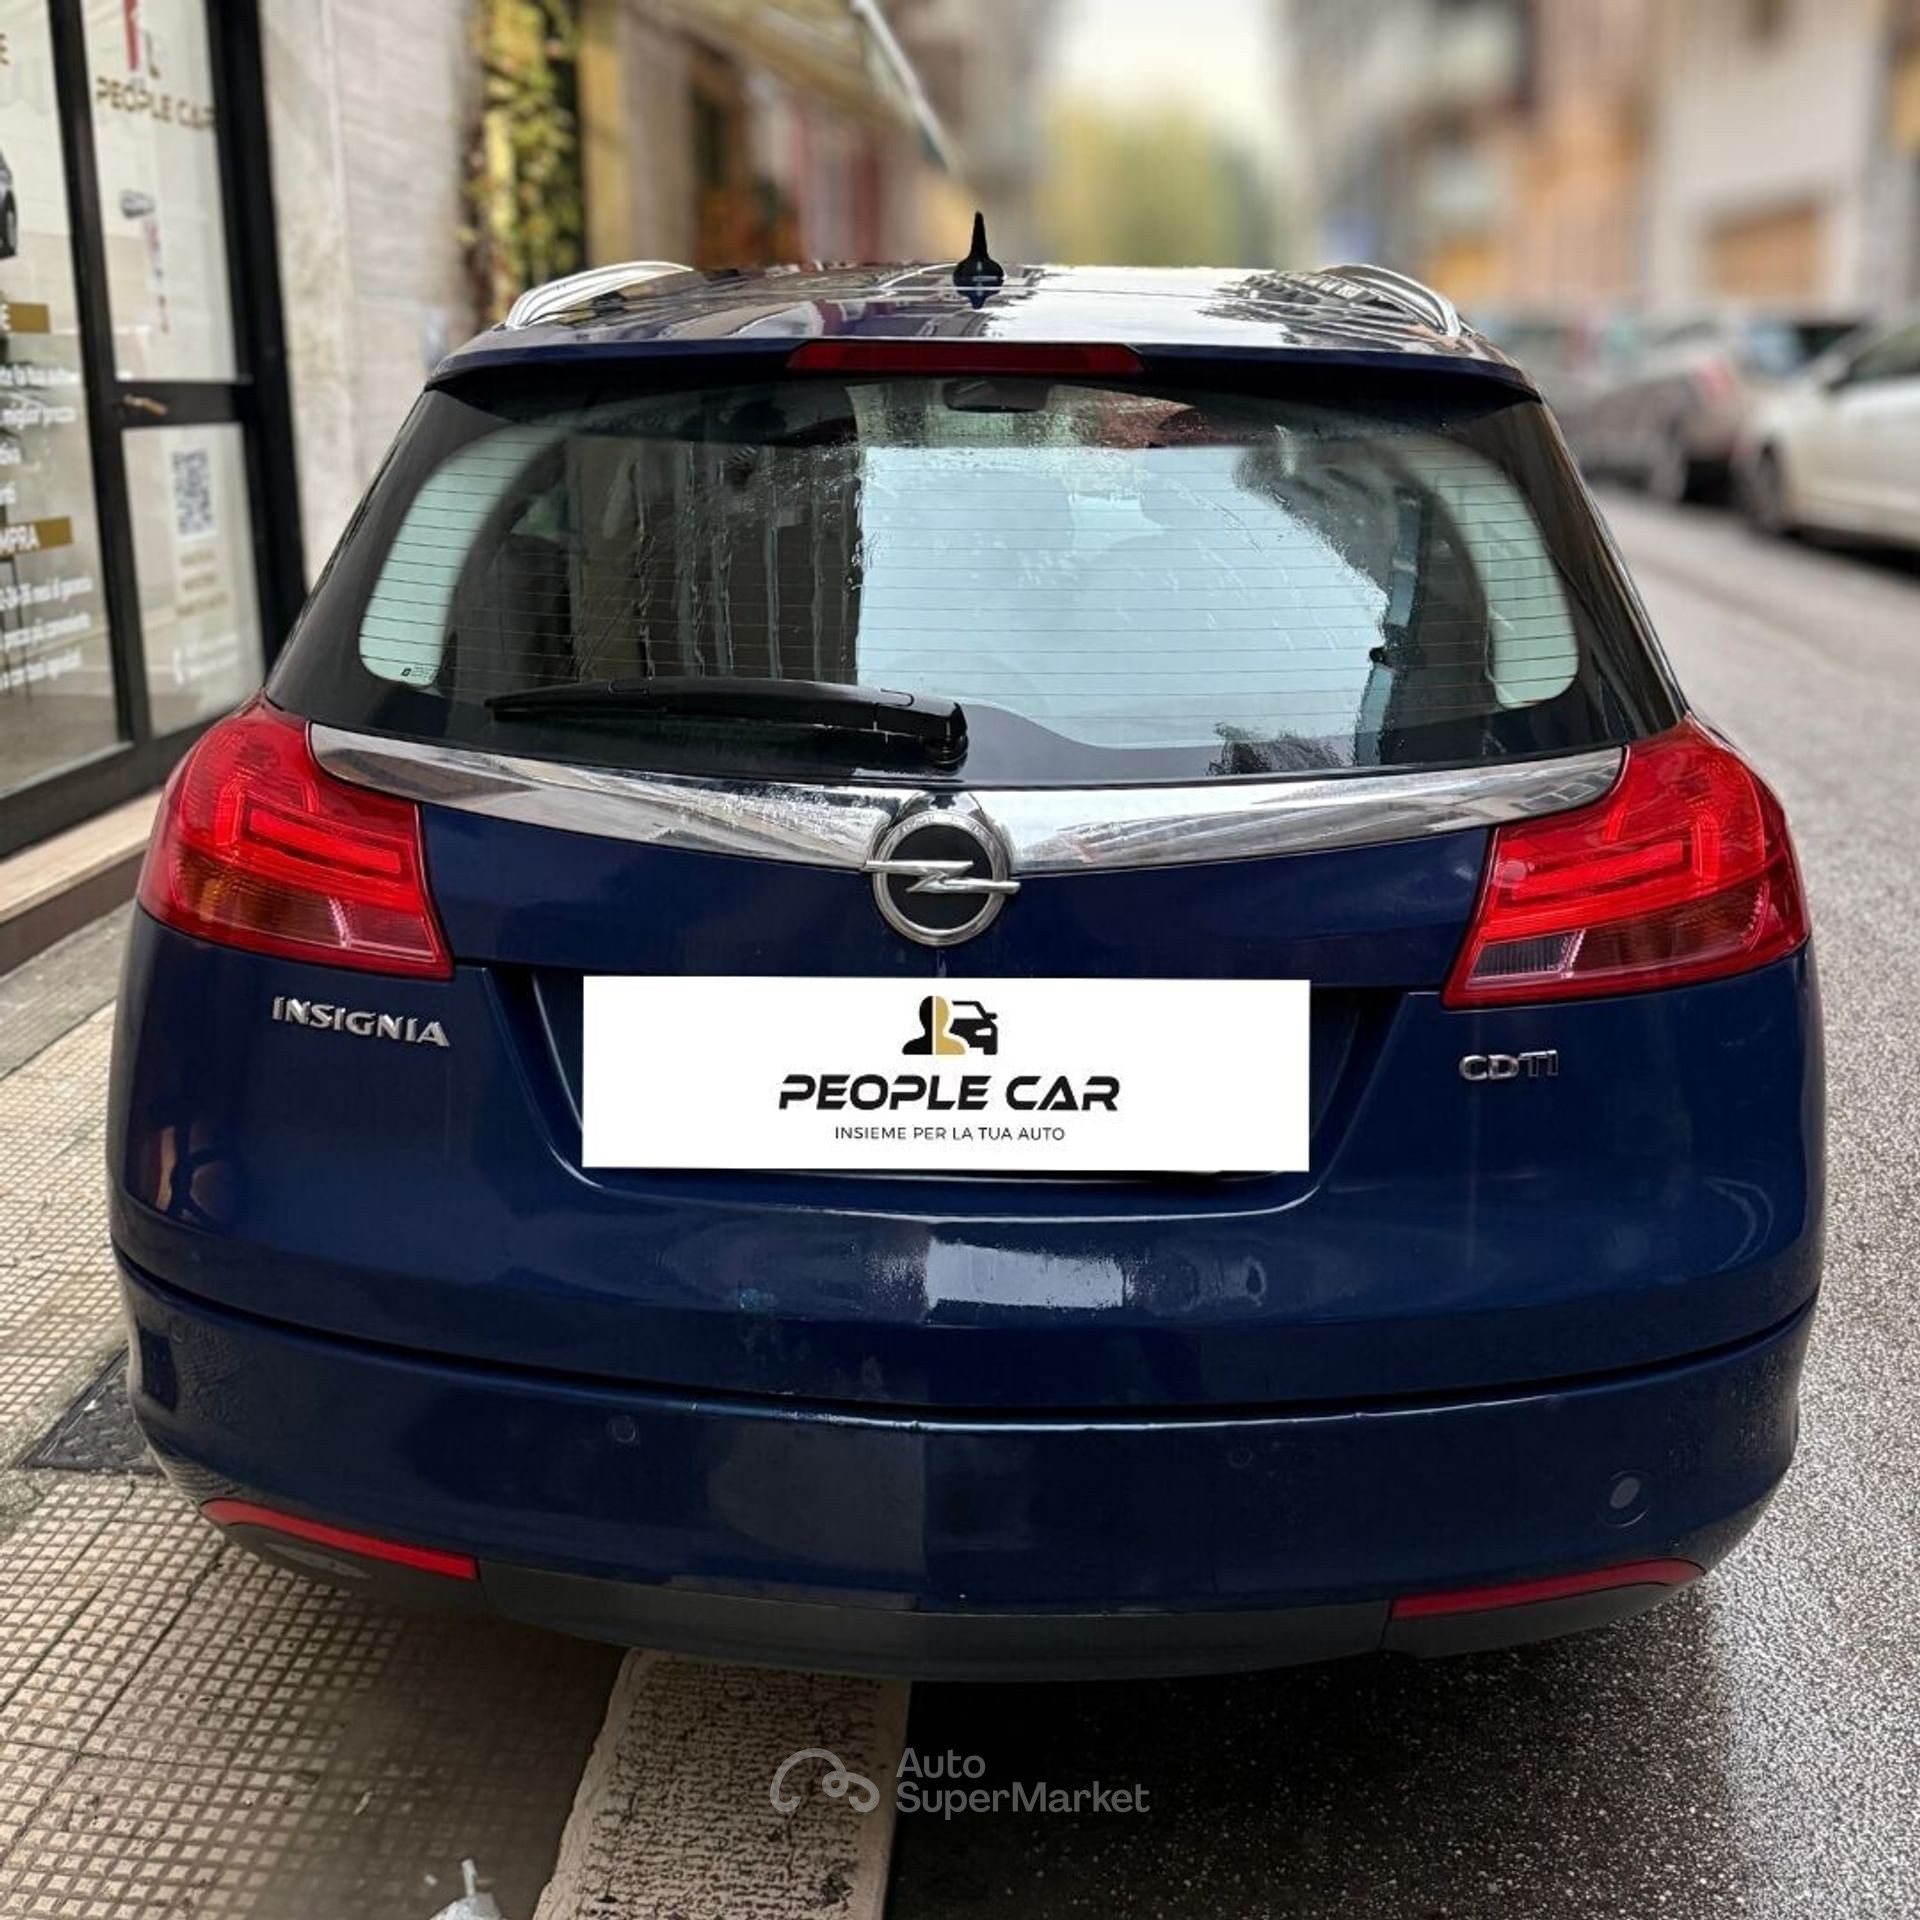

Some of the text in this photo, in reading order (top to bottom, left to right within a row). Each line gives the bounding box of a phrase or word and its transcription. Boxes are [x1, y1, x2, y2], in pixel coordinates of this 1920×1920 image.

[96, 76, 171, 122] PEOPLE
[271, 995, 450, 1048] INSIGNIA
[1459, 1049, 1559, 1081] CDTI
